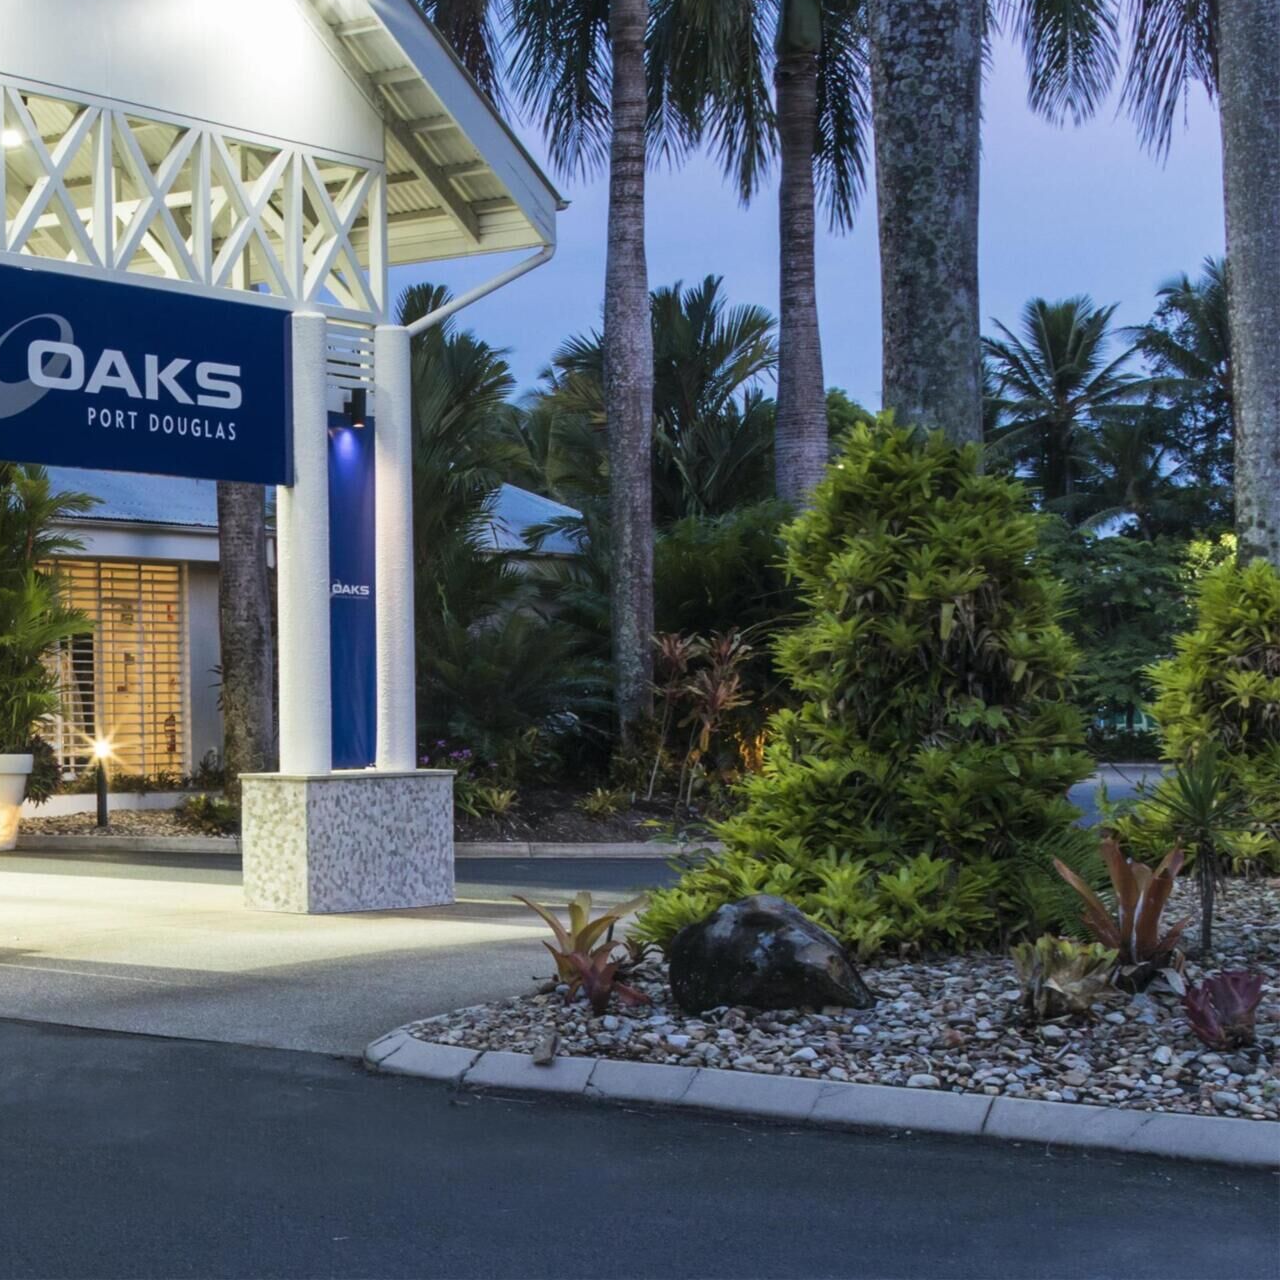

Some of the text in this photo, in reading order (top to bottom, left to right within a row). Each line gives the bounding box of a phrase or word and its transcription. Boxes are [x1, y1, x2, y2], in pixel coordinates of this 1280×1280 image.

[27, 339, 242, 409] OAKS
[87, 407, 236, 441] PORT DOUGLAS
[332, 583, 370, 595] OAKS
